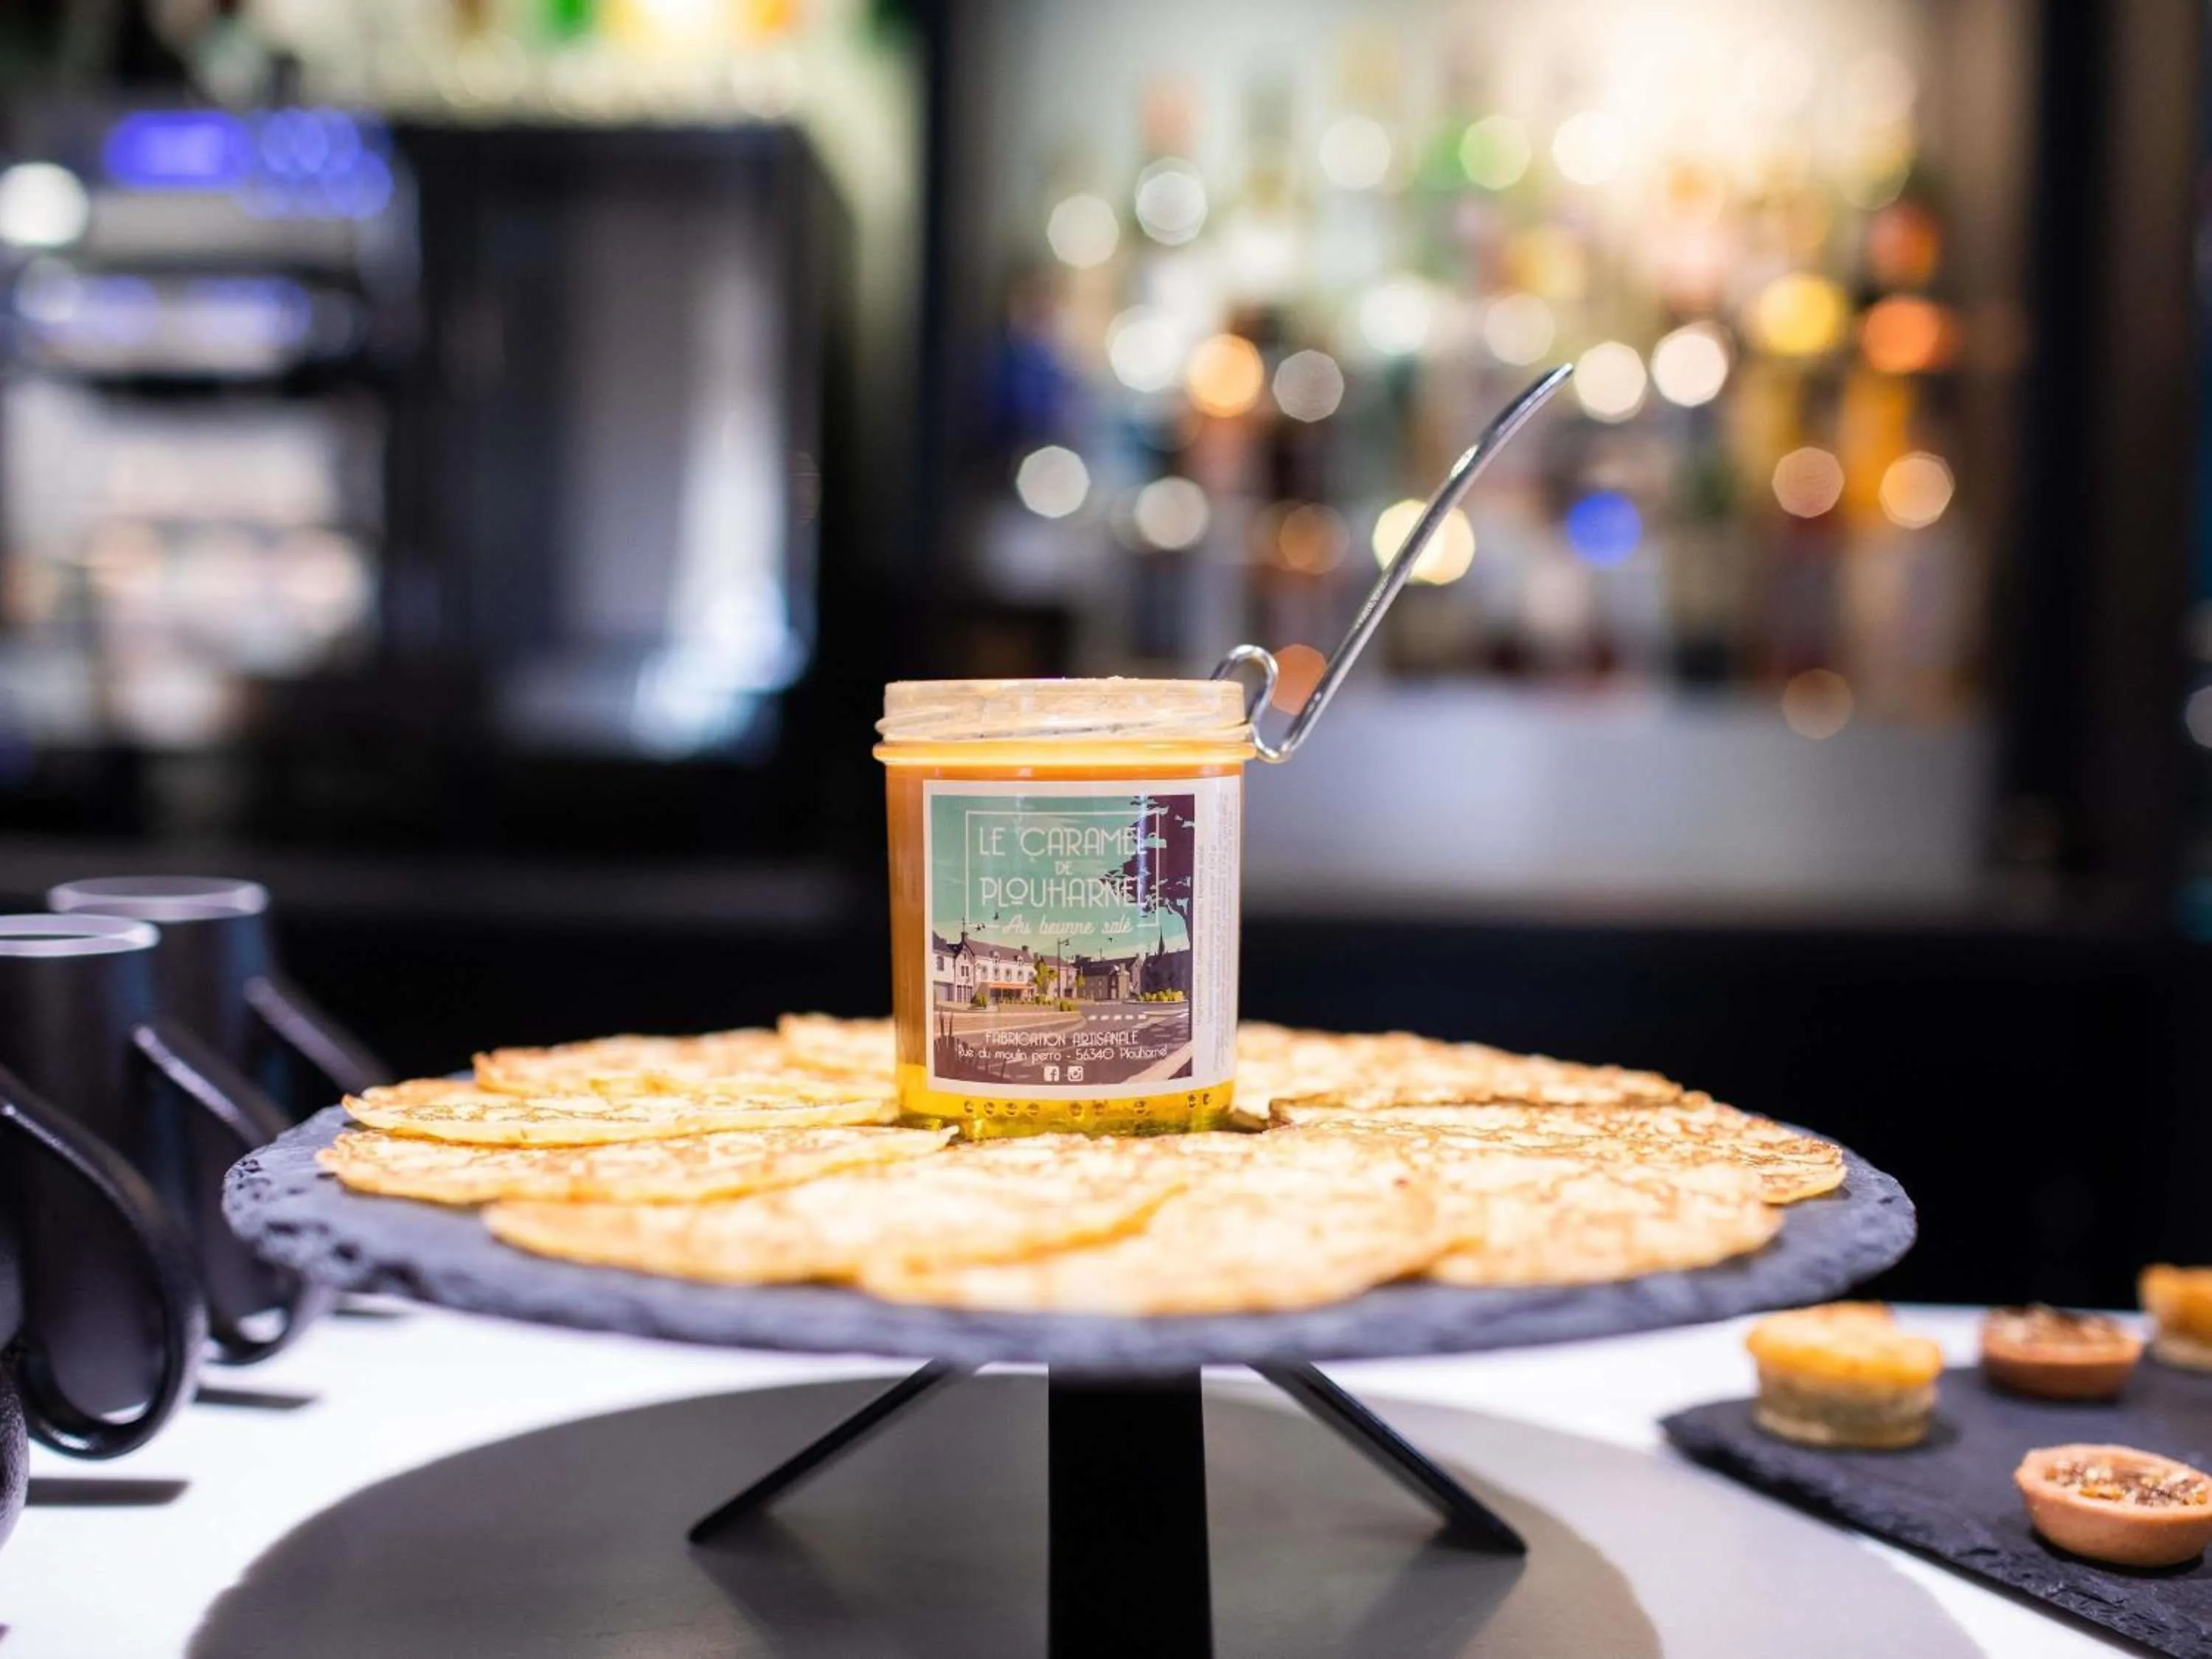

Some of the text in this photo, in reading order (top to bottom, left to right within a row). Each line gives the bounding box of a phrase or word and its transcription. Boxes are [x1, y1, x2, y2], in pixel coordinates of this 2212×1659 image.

[979, 827, 1006, 857] LE
[1055, 861, 1073, 875] DE
[980, 877, 1147, 908] PLOUHARNEL
[986, 1031, 1138, 1046] FABRICATION ARTISANALE
[978, 1047, 990, 1059] du
[1076, 1047, 1114, 1060] 56340
